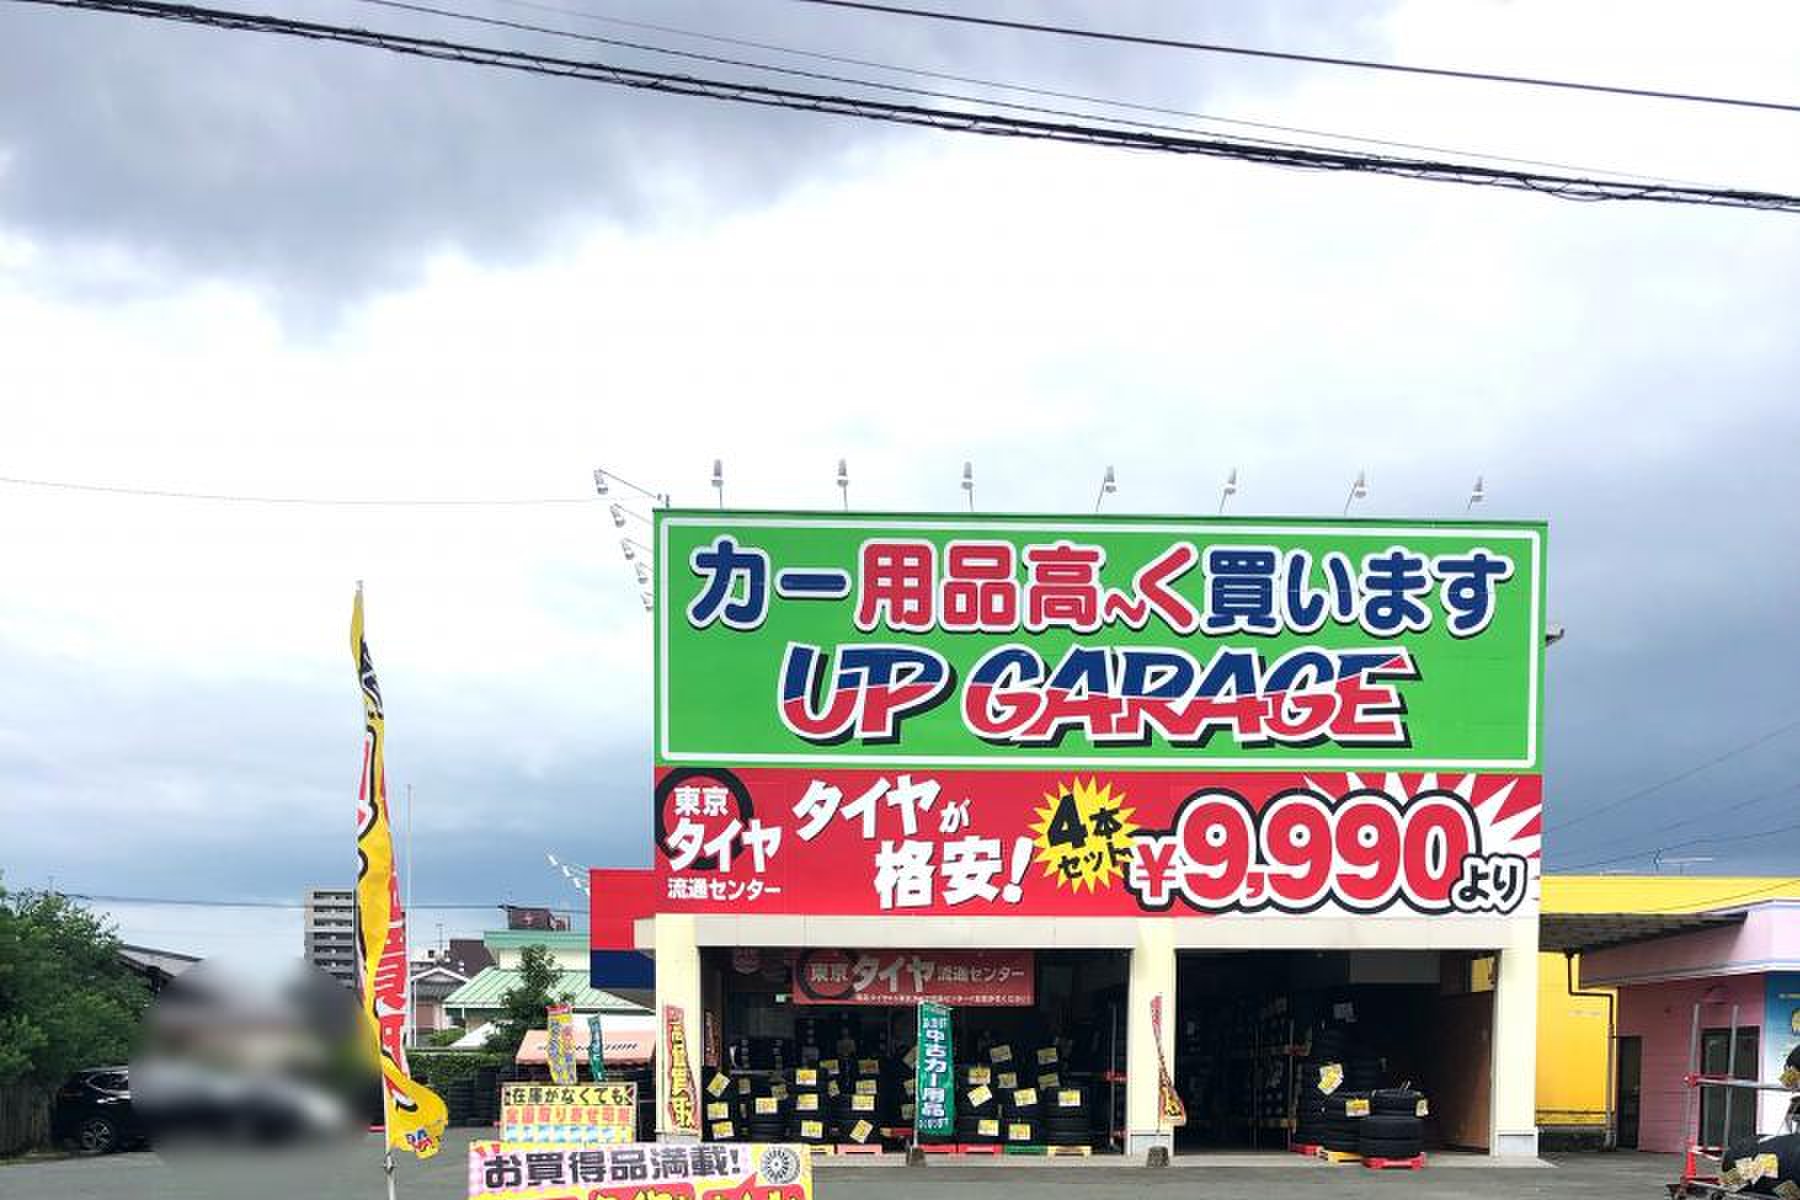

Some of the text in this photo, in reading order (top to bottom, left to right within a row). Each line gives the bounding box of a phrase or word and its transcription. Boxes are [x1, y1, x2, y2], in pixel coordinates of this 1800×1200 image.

[778, 641, 1421, 749] UP GARAGE
[674, 785, 729, 816] 東京
[792, 774, 972, 842] タイヤが
[667, 817, 782, 872] タイヤ
[1058, 841, 1137, 880] セット
[667, 878, 781, 900] 流通センター
[512, 1087, 624, 1104] 在庫がなくても
